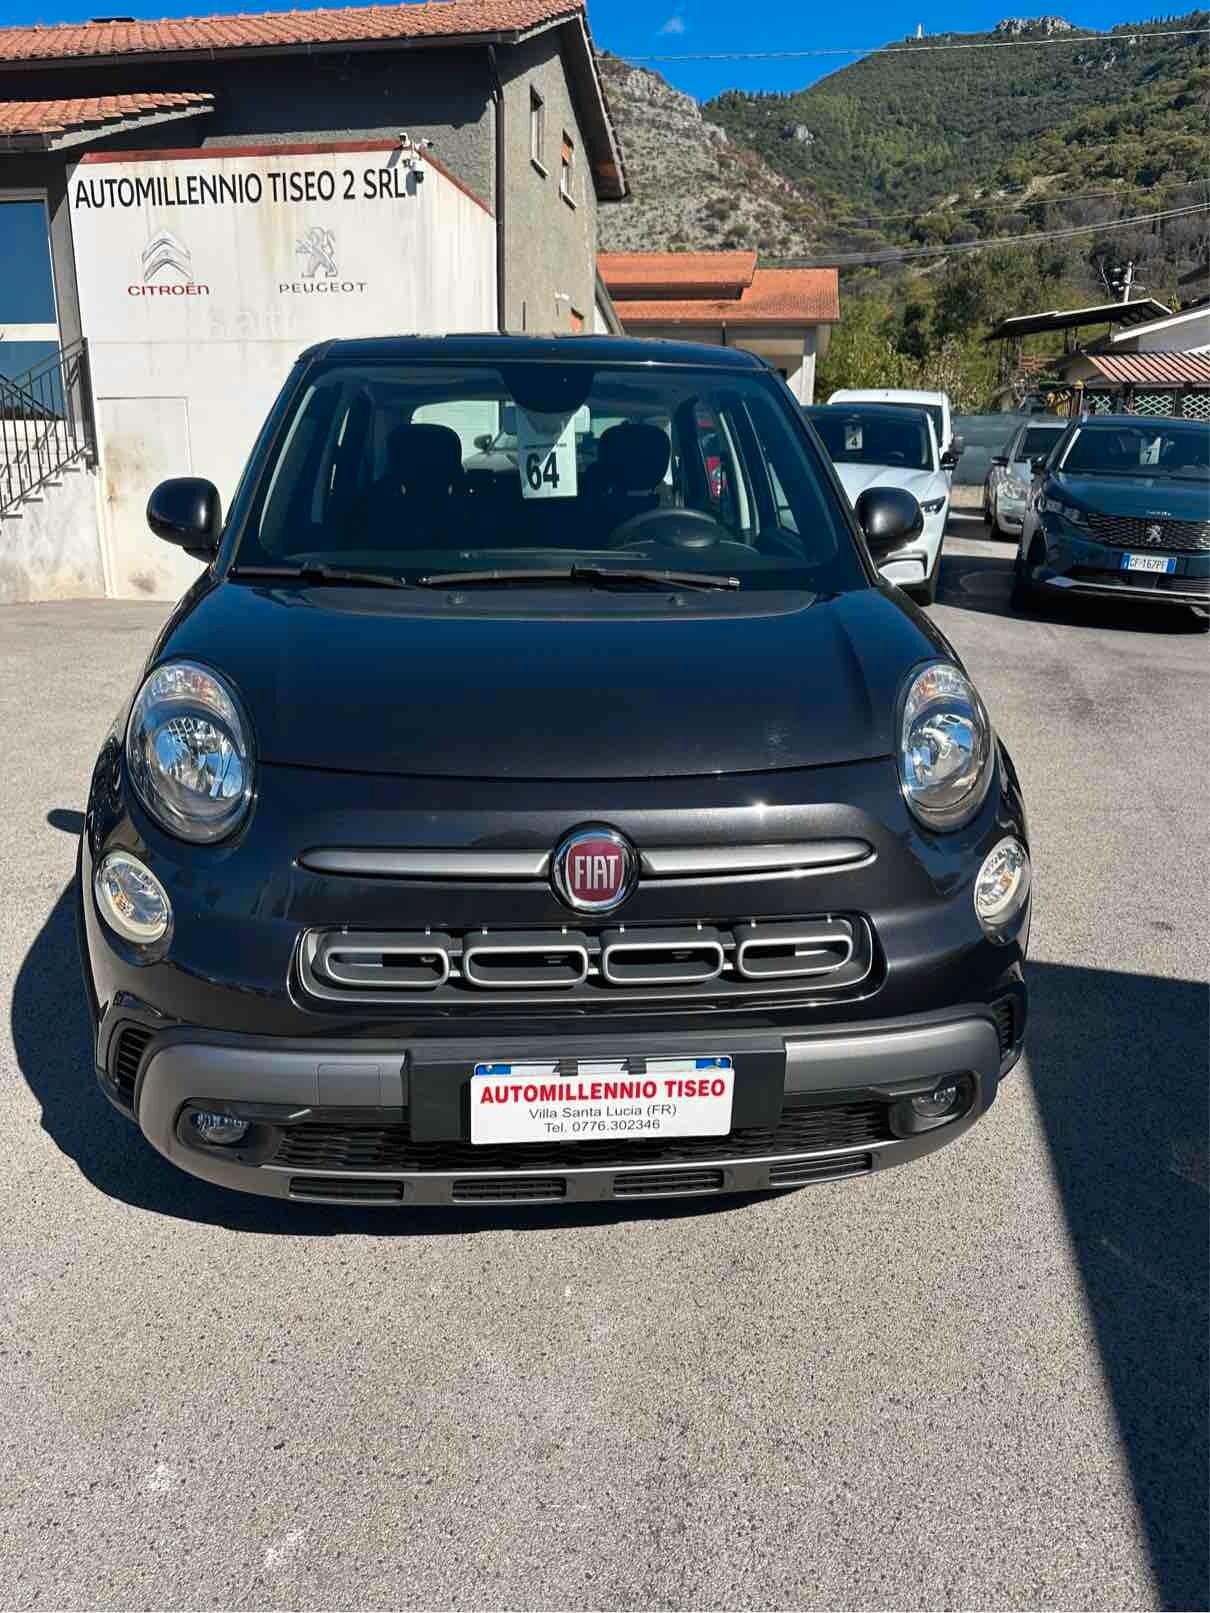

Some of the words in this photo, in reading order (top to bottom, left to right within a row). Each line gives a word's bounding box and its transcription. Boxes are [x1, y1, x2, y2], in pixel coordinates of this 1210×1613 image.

[75, 172, 263, 209] AUTOMILLENNIO
[267, 169, 335, 203] TISEO
[342, 170, 357, 200] 2
[363, 167, 406, 199] SRL
[279, 281, 368, 295] PEUGEOT
[526, 451, 561, 490] 64
[574, 854, 619, 889] FIAT
[480, 1080, 658, 1105] AUTOMILLENNIO
[664, 1078, 726, 1098] TISEO
[528, 1108, 558, 1121] Villa
[562, 1106, 601, 1119] Santa
[606, 1105, 643, 1117] Lucia
[646, 1103, 678, 1117] (FR)
[543, 1121, 567, 1134] Tel.
[572, 1118, 661, 1133] 0776.302346
